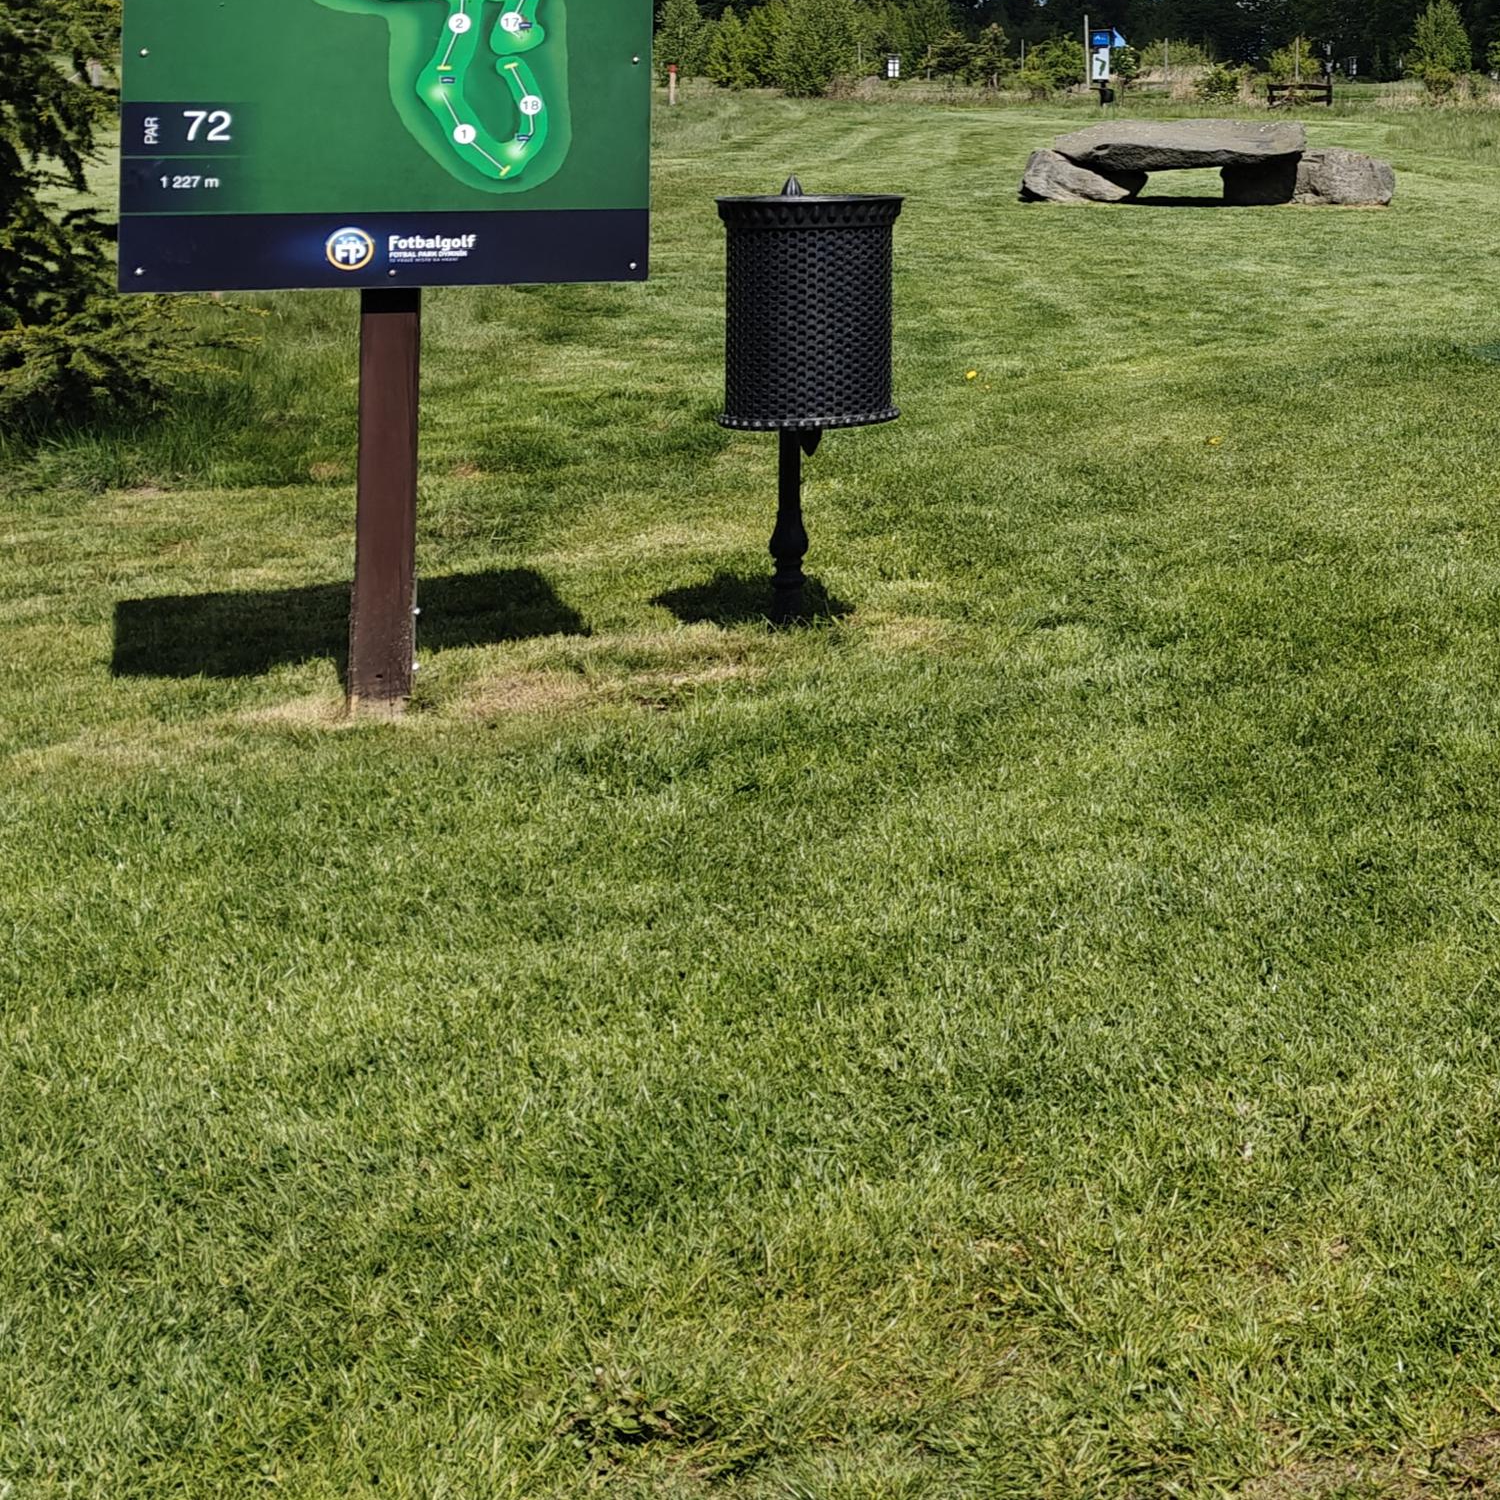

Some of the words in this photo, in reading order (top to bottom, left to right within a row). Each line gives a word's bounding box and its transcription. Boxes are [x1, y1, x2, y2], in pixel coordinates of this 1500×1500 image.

[455, 18, 464, 29] 2
[503, 17, 519, 28] 17
[523, 99, 540, 111] 18
[144, 116, 159, 144] PAR
[183, 110, 232, 141] 72
[461, 128, 468, 139] 1
[160, 175, 168, 188] 1
[172, 175, 201, 188] 227
[204, 178, 219, 188] m
[388, 234, 477, 251] Fotbalgolf
